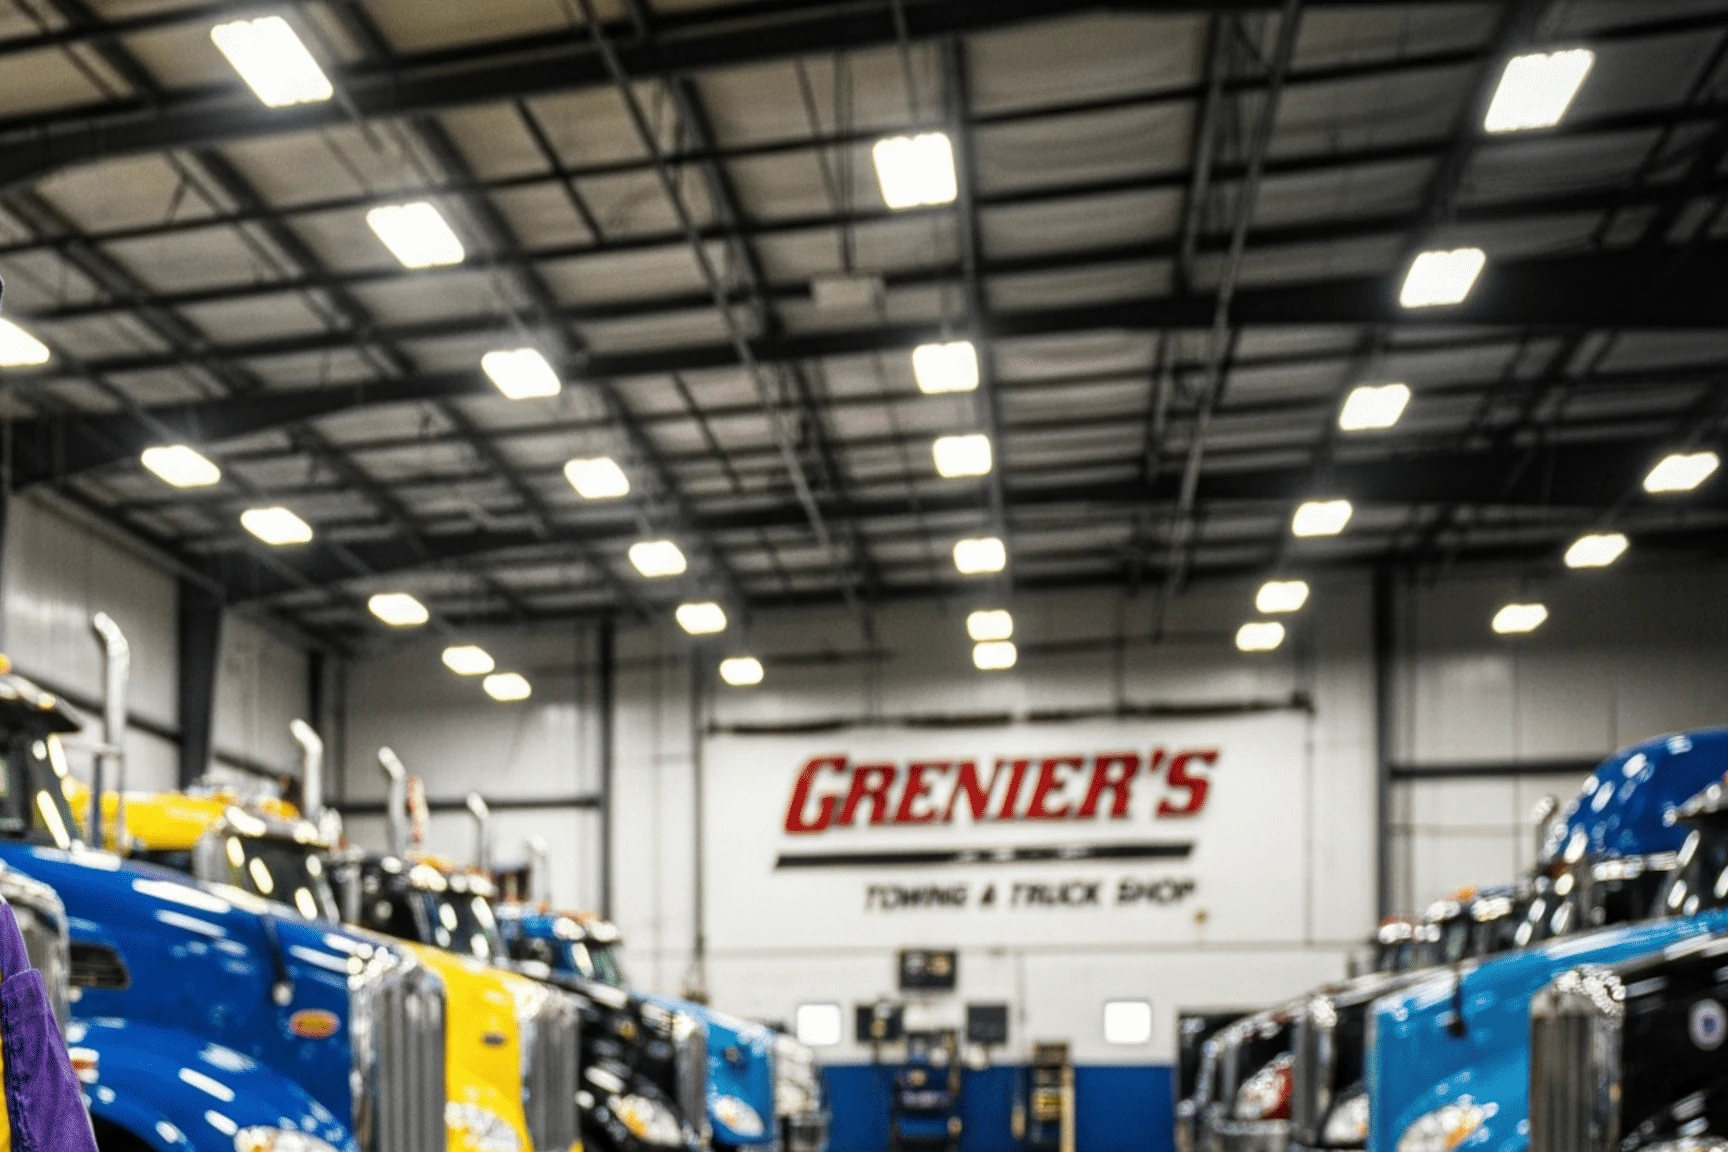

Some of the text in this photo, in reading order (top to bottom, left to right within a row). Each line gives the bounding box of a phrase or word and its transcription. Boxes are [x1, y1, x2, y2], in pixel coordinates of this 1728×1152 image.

[782, 748, 1220, 836] GRENIER'S
[1010, 879, 1101, 908] TRUCK
[1115, 875, 1198, 906] SHOP
